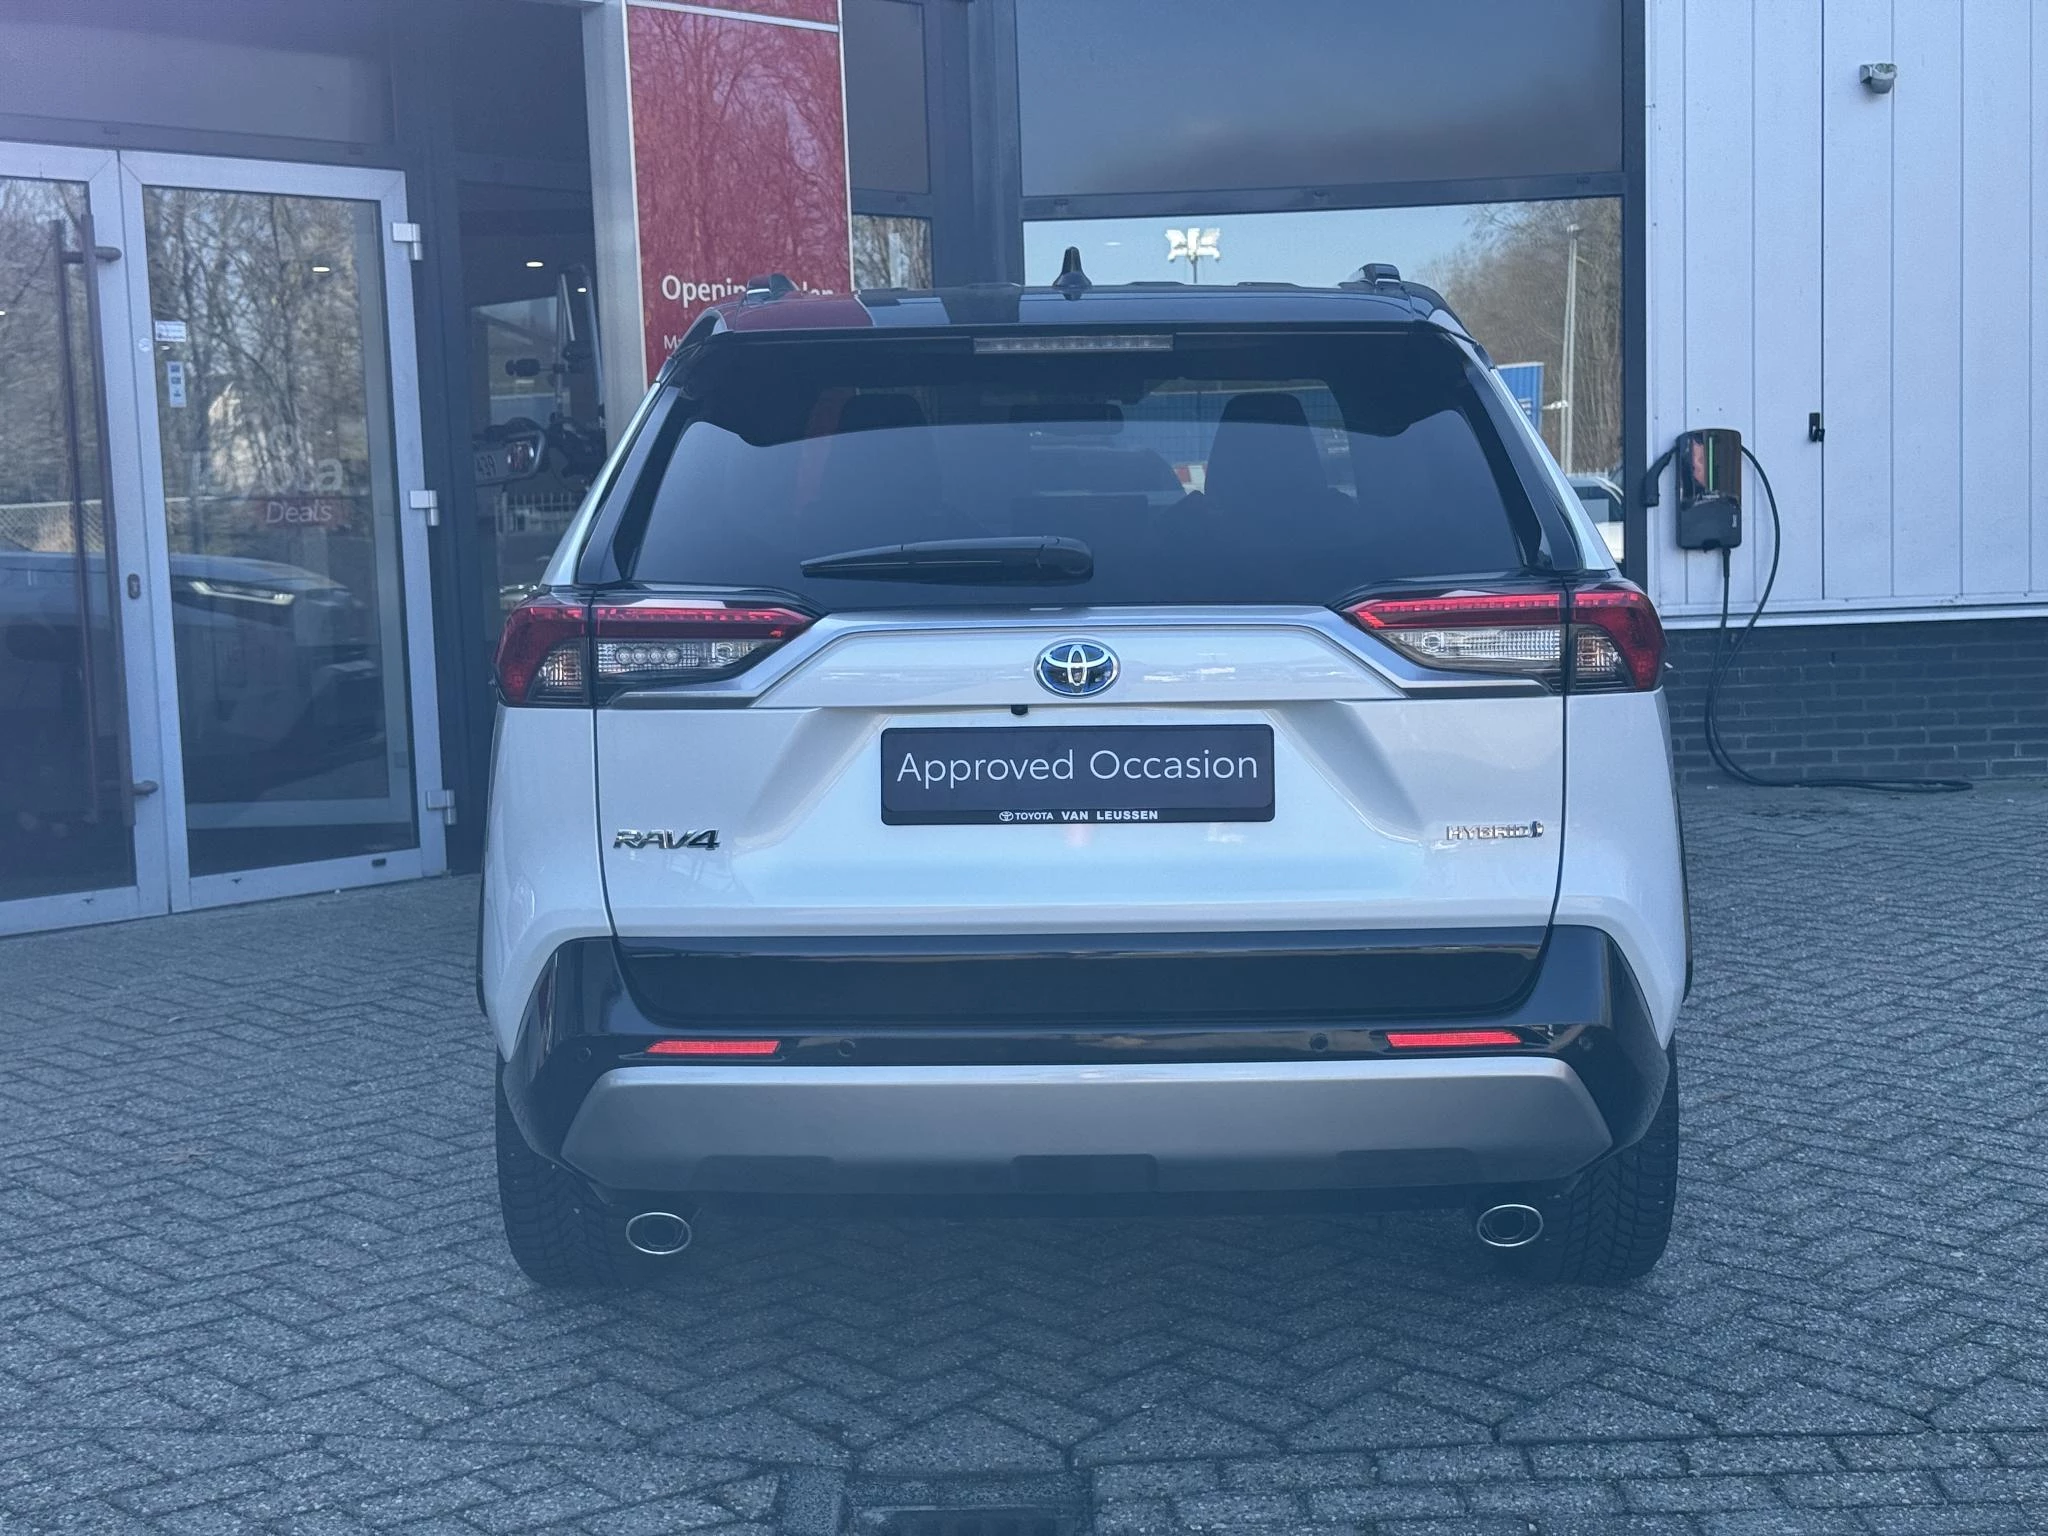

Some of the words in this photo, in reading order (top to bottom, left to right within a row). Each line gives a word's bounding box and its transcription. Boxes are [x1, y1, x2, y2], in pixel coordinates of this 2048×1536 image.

[266, 499, 333, 524] Deals
[897, 749, 1074, 789] Approved
[1089, 749, 1258, 780] Occasion
[1014, 811, 1054, 821] TOYOTA
[1061, 810, 1089, 821] VAN
[1096, 810, 1159, 821] LEUSSEN
[613, 828, 720, 851] RAV4
[1446, 824, 1528, 840] HYBRID
